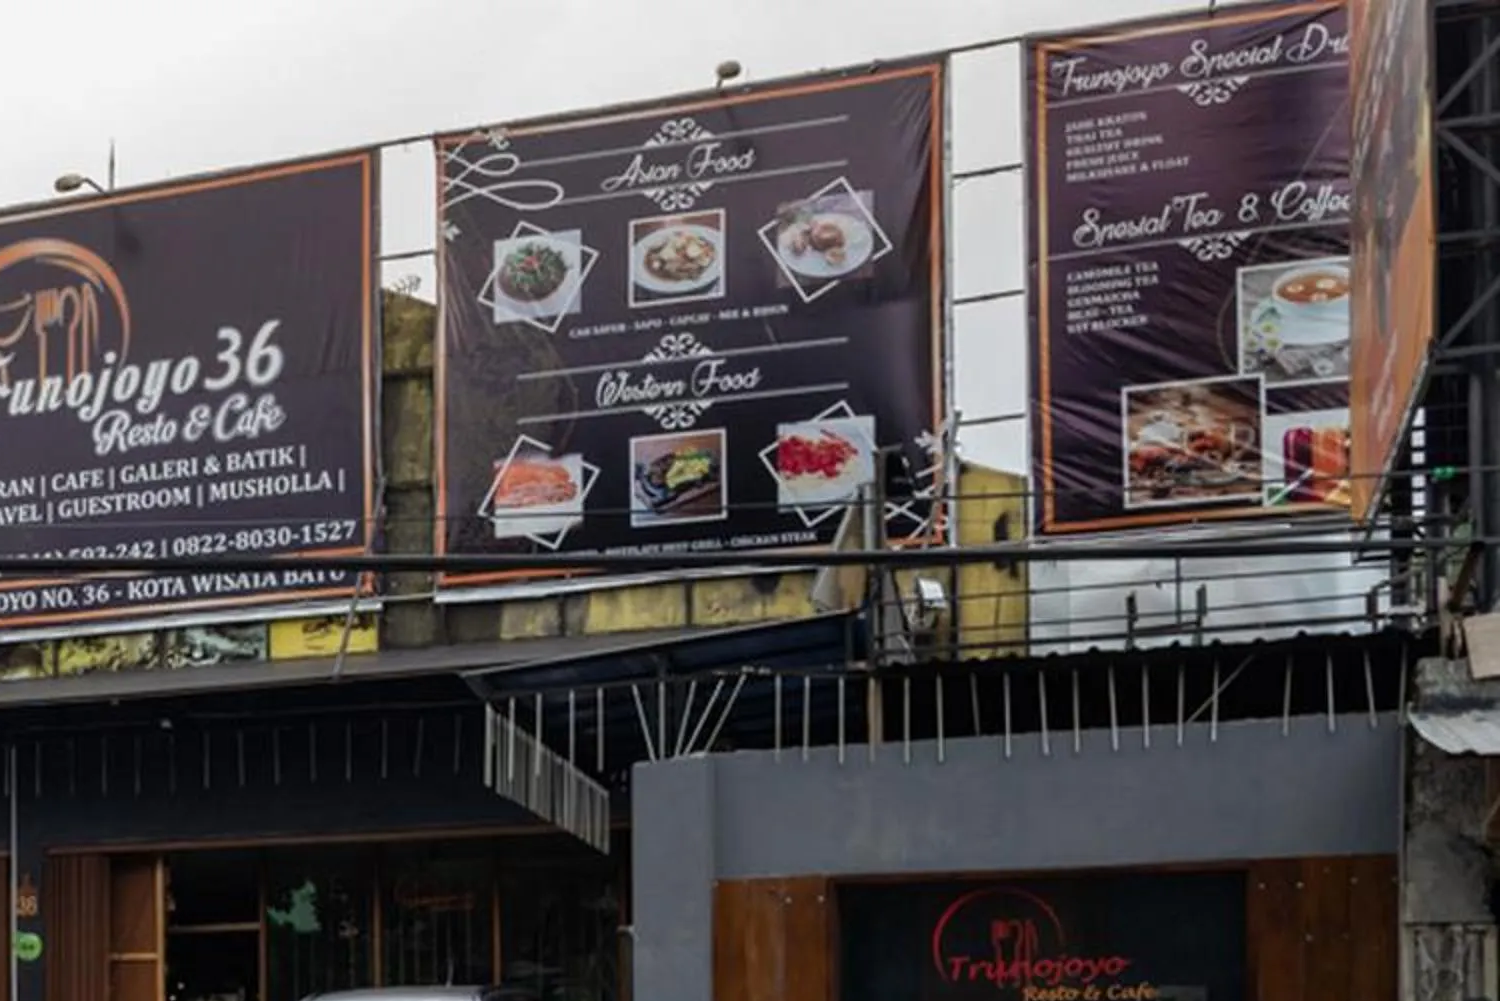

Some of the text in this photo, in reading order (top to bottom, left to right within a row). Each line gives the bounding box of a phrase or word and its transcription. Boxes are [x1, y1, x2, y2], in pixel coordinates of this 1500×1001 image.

[1099, 127, 1123, 139] TEA
[600, 142, 756, 191] Asian Food
[1152, 156, 1189, 170] FLOAT
[1172, 192, 1223, 232] Tea
[1135, 261, 1158, 272] TEA
[1135, 274, 1159, 287] TEA
[204, 320, 284, 390] 36
[596, 359, 760, 408] Western Food
[93, 409, 178, 456] Resto
[184, 404, 211, 441] &
[51, 468, 105, 492] CAFE
[120, 457, 198, 484] GALERI
[203, 454, 220, 475] &
[226, 446, 294, 472] BATIK
[58, 485, 191, 518] GUESTROOM
[209, 470, 332, 502] MUSHOLLA
[173, 520, 356, 557] 0822-8030-1527
[781, 531, 817, 543] STEAK
[41, 587, 78, 608] NO.
[82, 583, 110, 605] 36
[128, 575, 187, 600] KOTA
[191, 570, 278, 593] WISATA
[948, 955, 1131, 985] Trunojoyo
[1022, 981, 1160, 1001] Resto & Cafe
